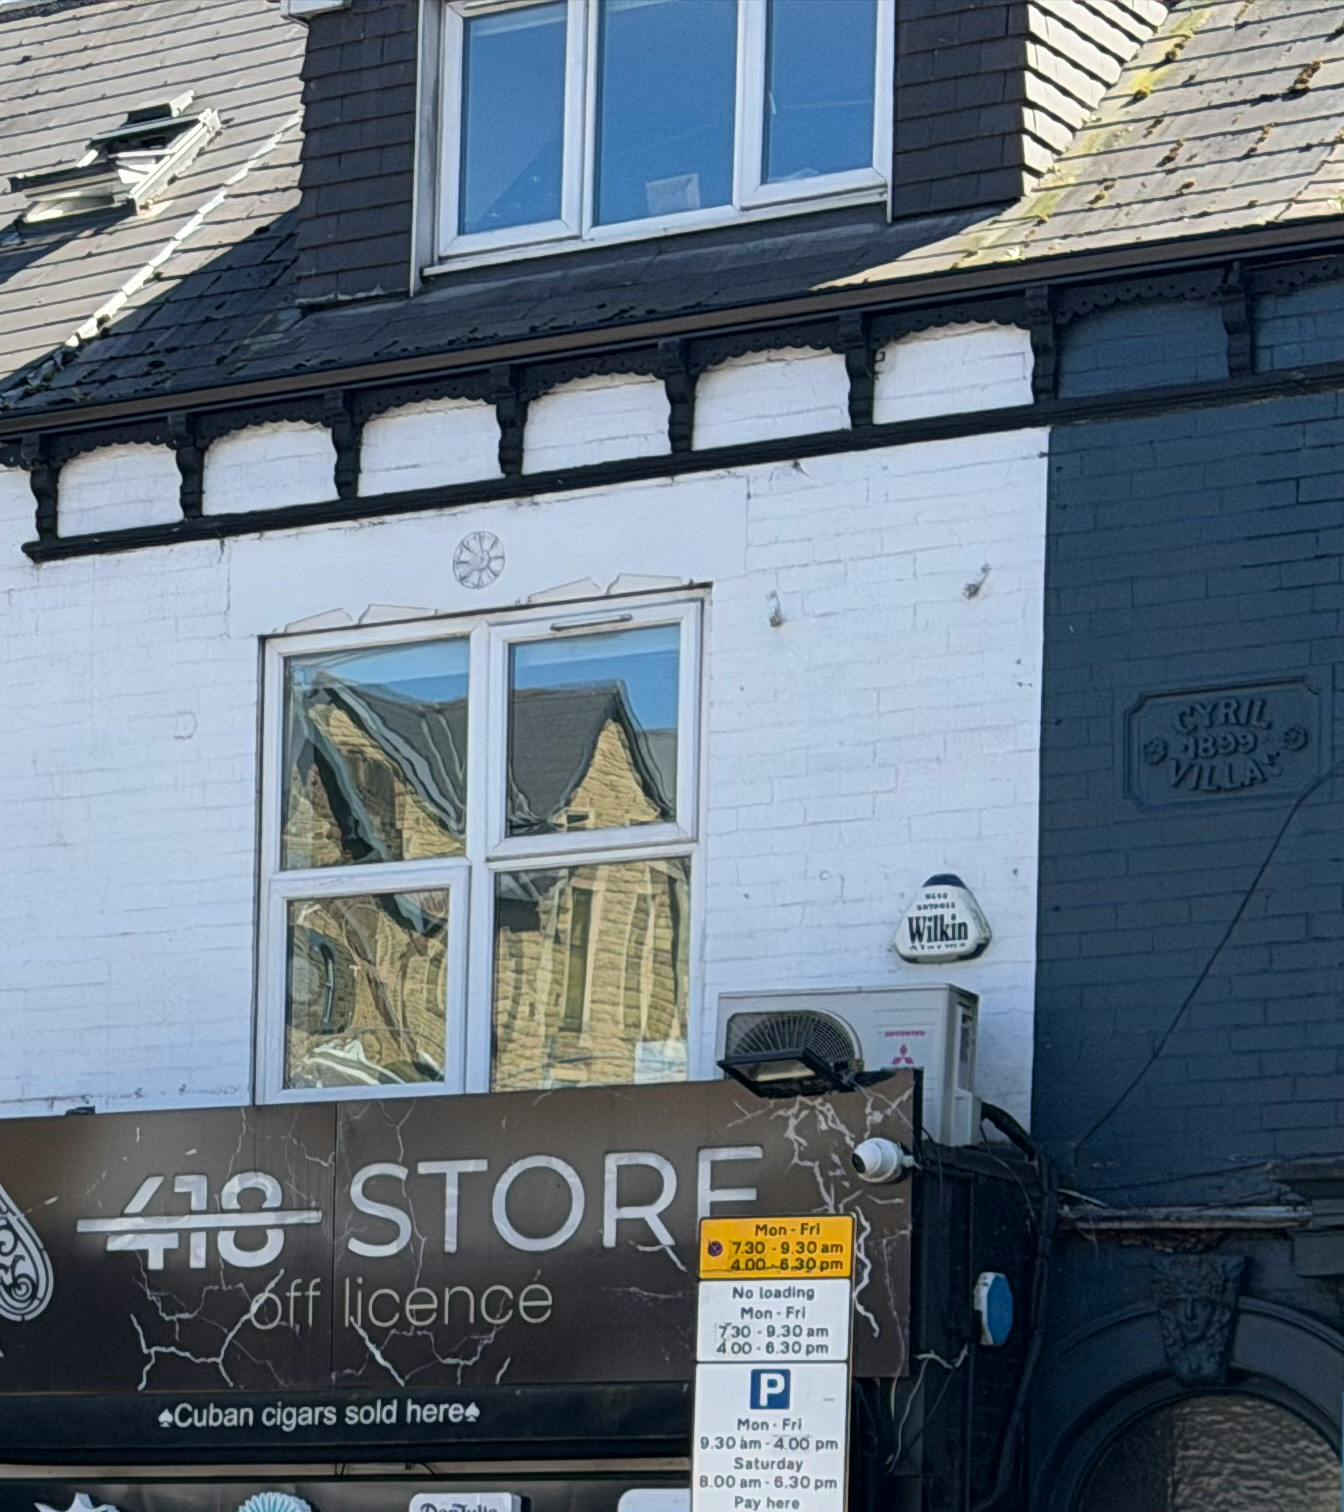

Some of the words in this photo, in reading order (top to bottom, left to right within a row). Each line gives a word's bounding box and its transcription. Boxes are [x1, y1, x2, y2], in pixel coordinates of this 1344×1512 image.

[1178, 699, 1273, 734] CYRIL
[1183, 731, 1258, 760] 1899
[908, 913, 969, 944] Wilkin
[106, 1170, 286, 1271] 418
[755, 1224, 787, 1237] Mon
[800, 1223, 821, 1236] Fri
[780, 1241, 817, 1256] 9.30
[821, 1244, 844, 1254] am
[780, 1258, 816, 1272] 6.30
[819, 1259, 844, 1272] pm
[732, 1286, 754, 1299] No
[759, 1286, 815, 1300] loading
[250, 1278, 322, 1330] off
[343, 1276, 554, 1329] licence
[741, 1307, 773, 1319] Mon
[785, 1306, 806, 1319] Fri
[766, 1325, 803, 1338] 9.30
[806, 1327, 829, 1337] am
[765, 1341, 802, 1355] 6.30
[805, 1343, 829, 1357] pm
[760, 1373, 785, 1407] P
[174, 1402, 254, 1428] Cuban
[262, 1401, 337, 1433] cigars
[345, 1398, 398, 1425] sold
[406, 1399, 464, 1425] here
[737, 1418, 769, 1431] Mon
[782, 1418, 802, 1430] Fri
[700, 1436, 736, 1450] 9.30
[740, 1438, 762, 1449] am
[815, 1439, 838, 1451] pm
[733, 1457, 804, 1472] Saturday
[699, 1475, 736, 1489] 8.00
[740, 1478, 762, 1489] am
[774, 1476, 810, 1489] 6.30
[814, 1478, 838, 1490] pm
[734, 1496, 761, 1511] Pay
[766, 1497, 800, 1509] here
